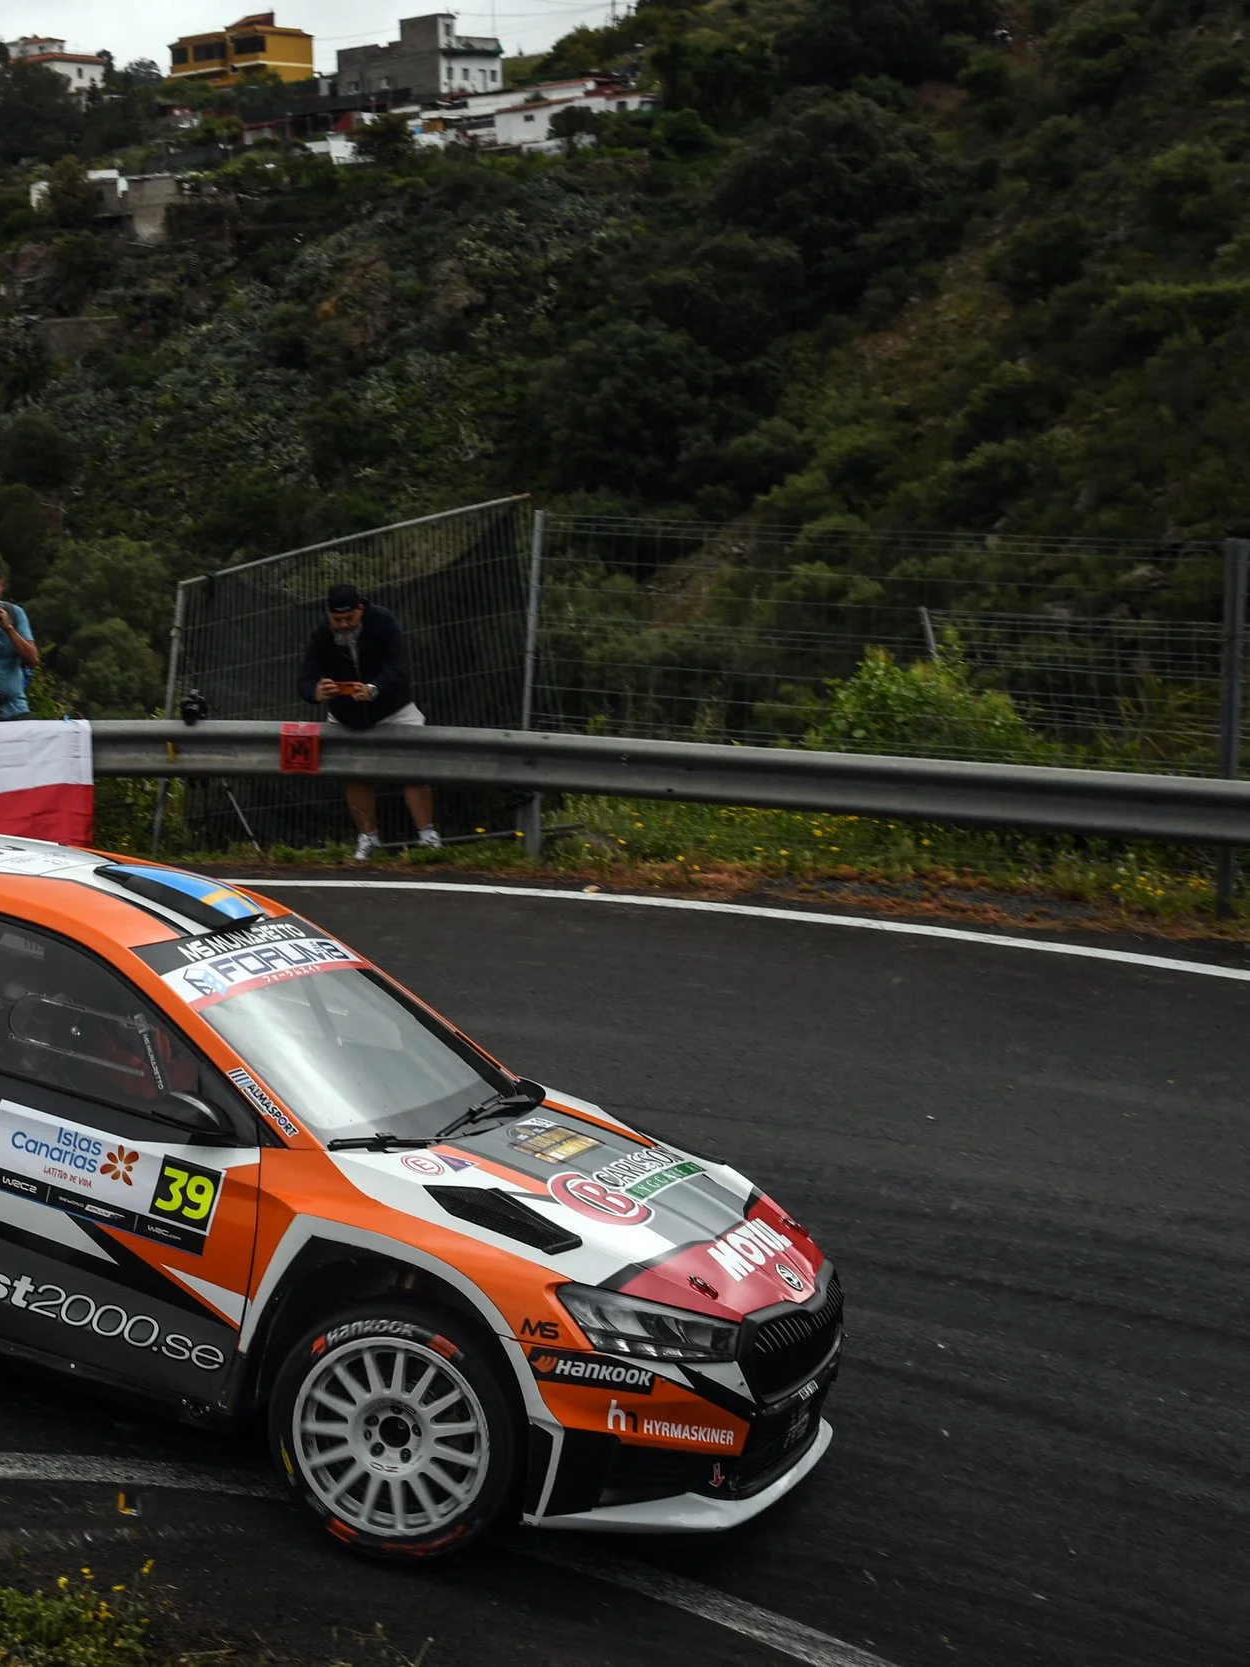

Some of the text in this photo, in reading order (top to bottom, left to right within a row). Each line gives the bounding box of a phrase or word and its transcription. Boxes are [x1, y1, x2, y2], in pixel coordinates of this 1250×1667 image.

[246, 1083, 299, 1137] ALMASPORT
[10, 1130, 99, 1174] Canarias
[56, 1126, 103, 1156] Islas
[154, 1165, 216, 1221] 39
[706, 1217, 794, 1283] MOTUL
[520, 1318, 560, 1341] MS
[642, 1418, 735, 1446] HYRMASKINER
